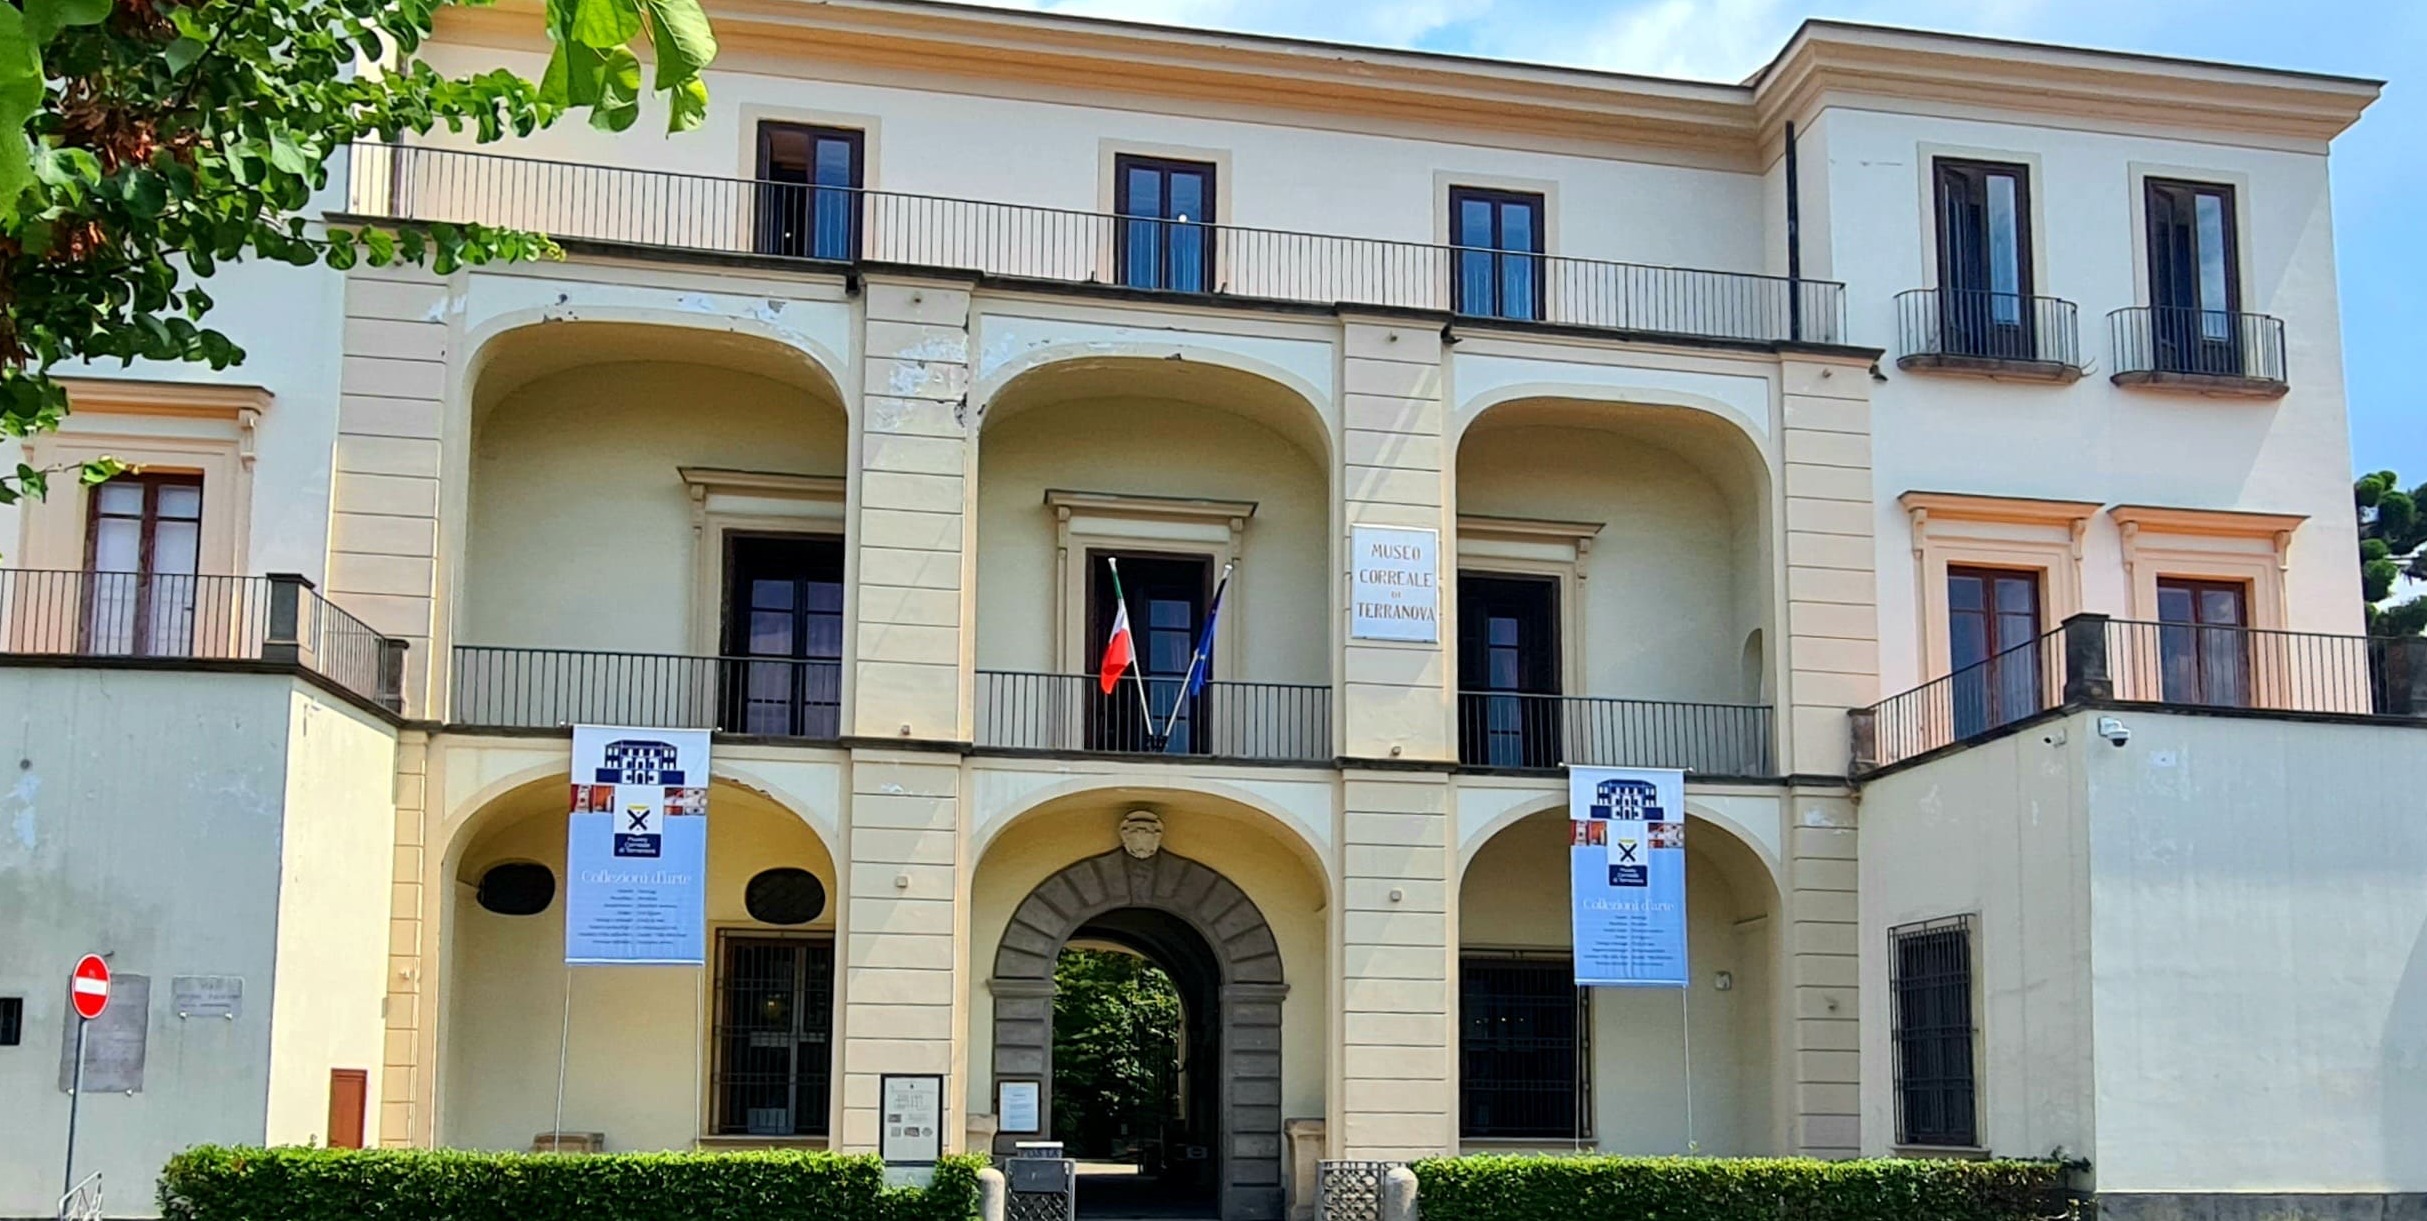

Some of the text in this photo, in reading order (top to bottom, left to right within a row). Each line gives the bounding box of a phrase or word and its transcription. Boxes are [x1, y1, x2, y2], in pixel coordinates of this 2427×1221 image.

[1371, 544, 1421, 560] MUSEO
[1360, 569, 1432, 588] CORREALE
[1391, 591, 1401, 599] DI
[1357, 602, 1435, 622] TERRANOVA
[581, 869, 648, 885] Collezioni
[1582, 897, 1675, 912] Collezioni d'arte
